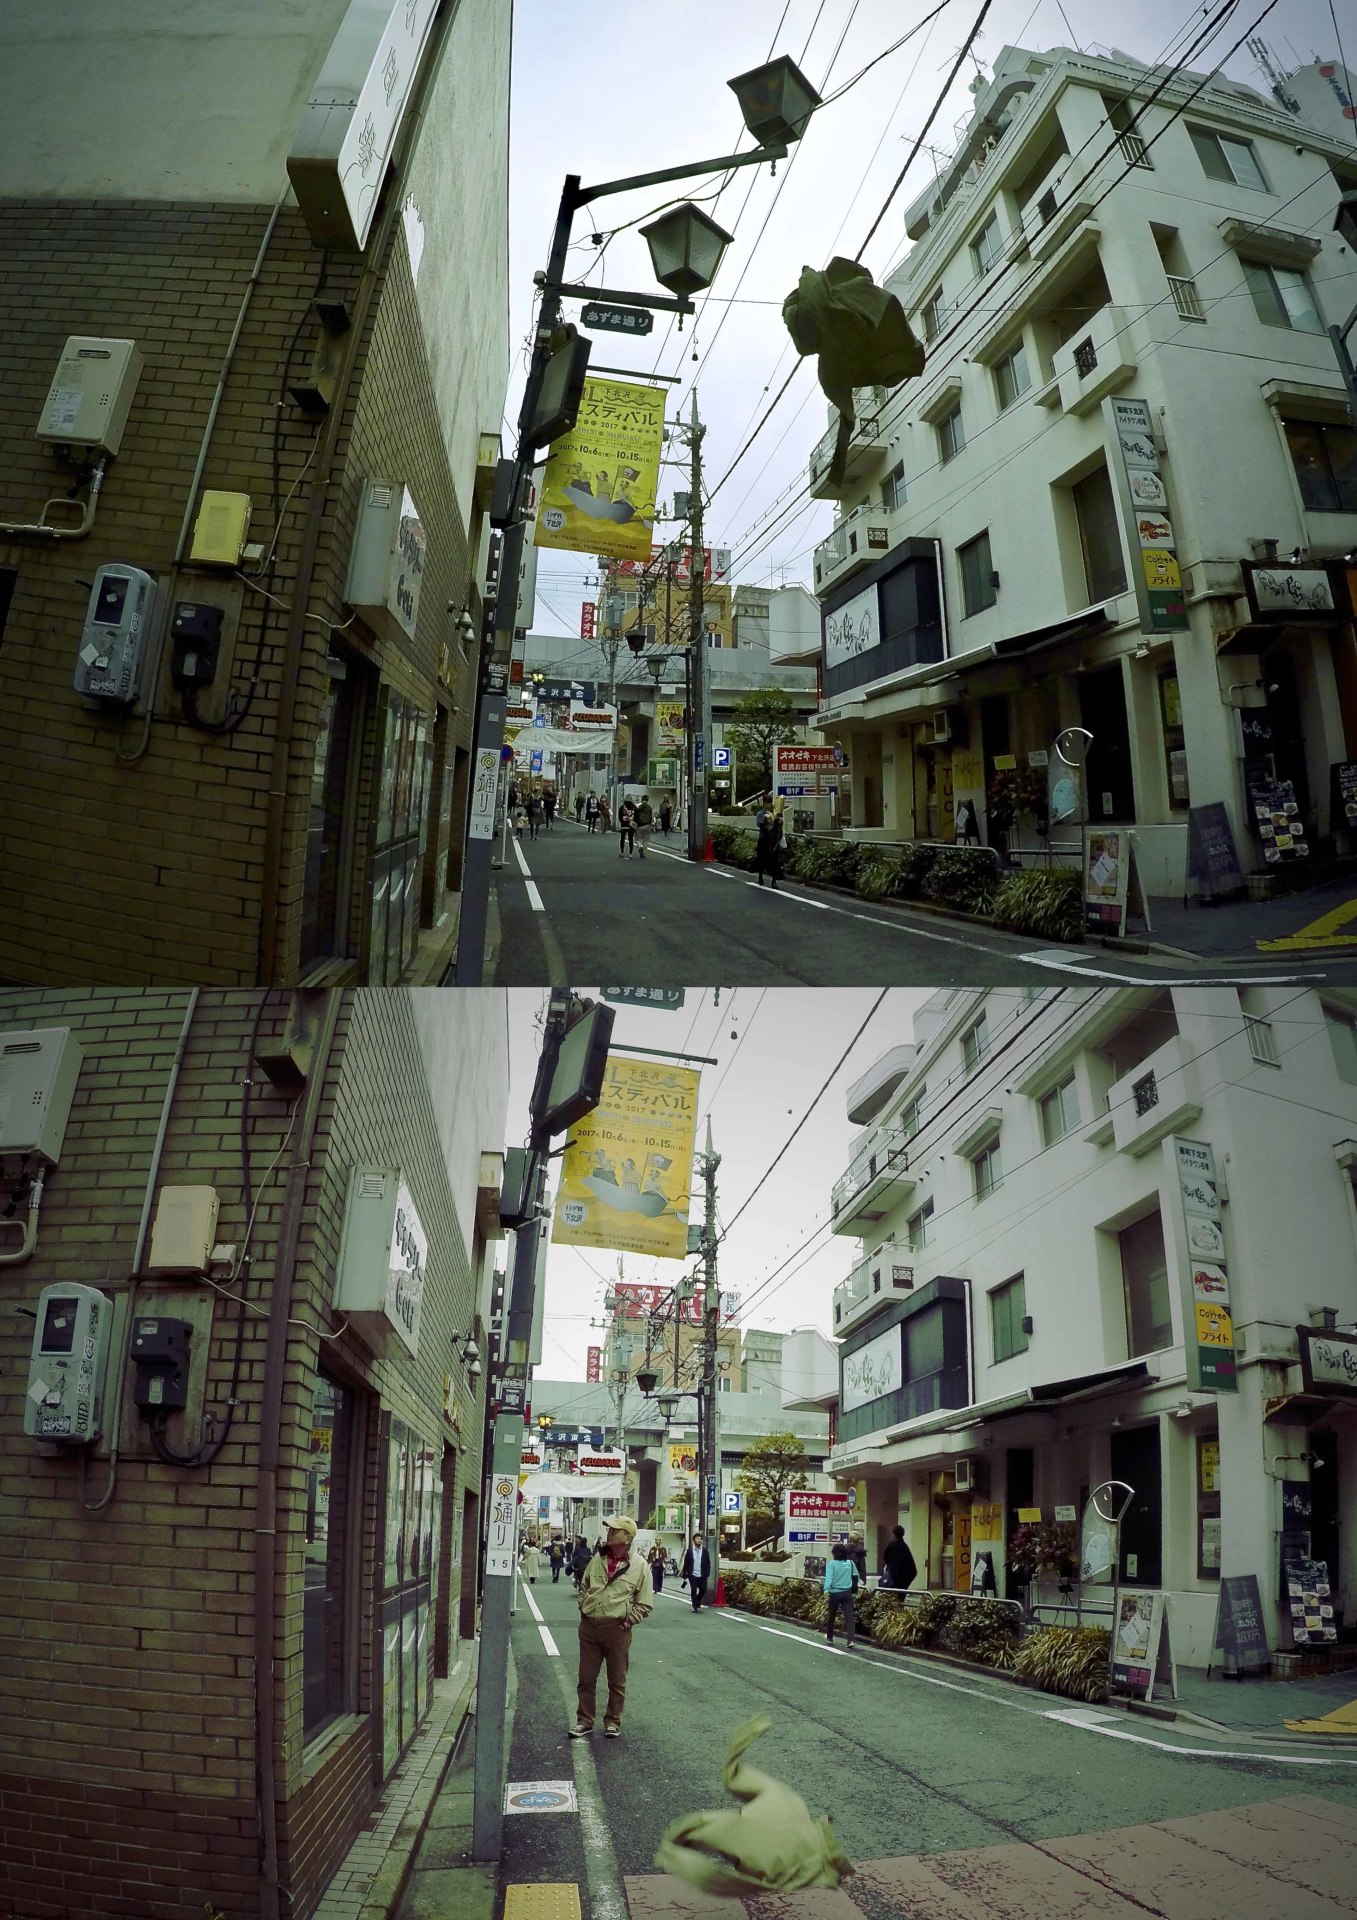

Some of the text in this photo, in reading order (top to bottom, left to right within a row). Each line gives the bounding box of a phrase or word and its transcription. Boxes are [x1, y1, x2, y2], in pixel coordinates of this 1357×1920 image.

[587, 311, 648, 327] あずま通り
[605, 388, 631, 399] 下北沢
[601, 422, 618, 430] 2017
[1147, 554, 1173, 563] Coffee
[1149, 577, 1176, 585] フライト
[584, 604, 593, 639] カラオケ
[716, 750, 727, 765] P
[780, 751, 810, 761] オオゼキ
[630, 1068, 659, 1080] 下北沢
[1199, 1308, 1227, 1320] Coffee
[1201, 1332, 1228, 1343] フライト
[589, 1348, 598, 1383] カラオケ
[725, 1495, 737, 1509] P
[792, 1496, 823, 1507] オオゼキ
[961, 1520, 970, 1565] TUC
